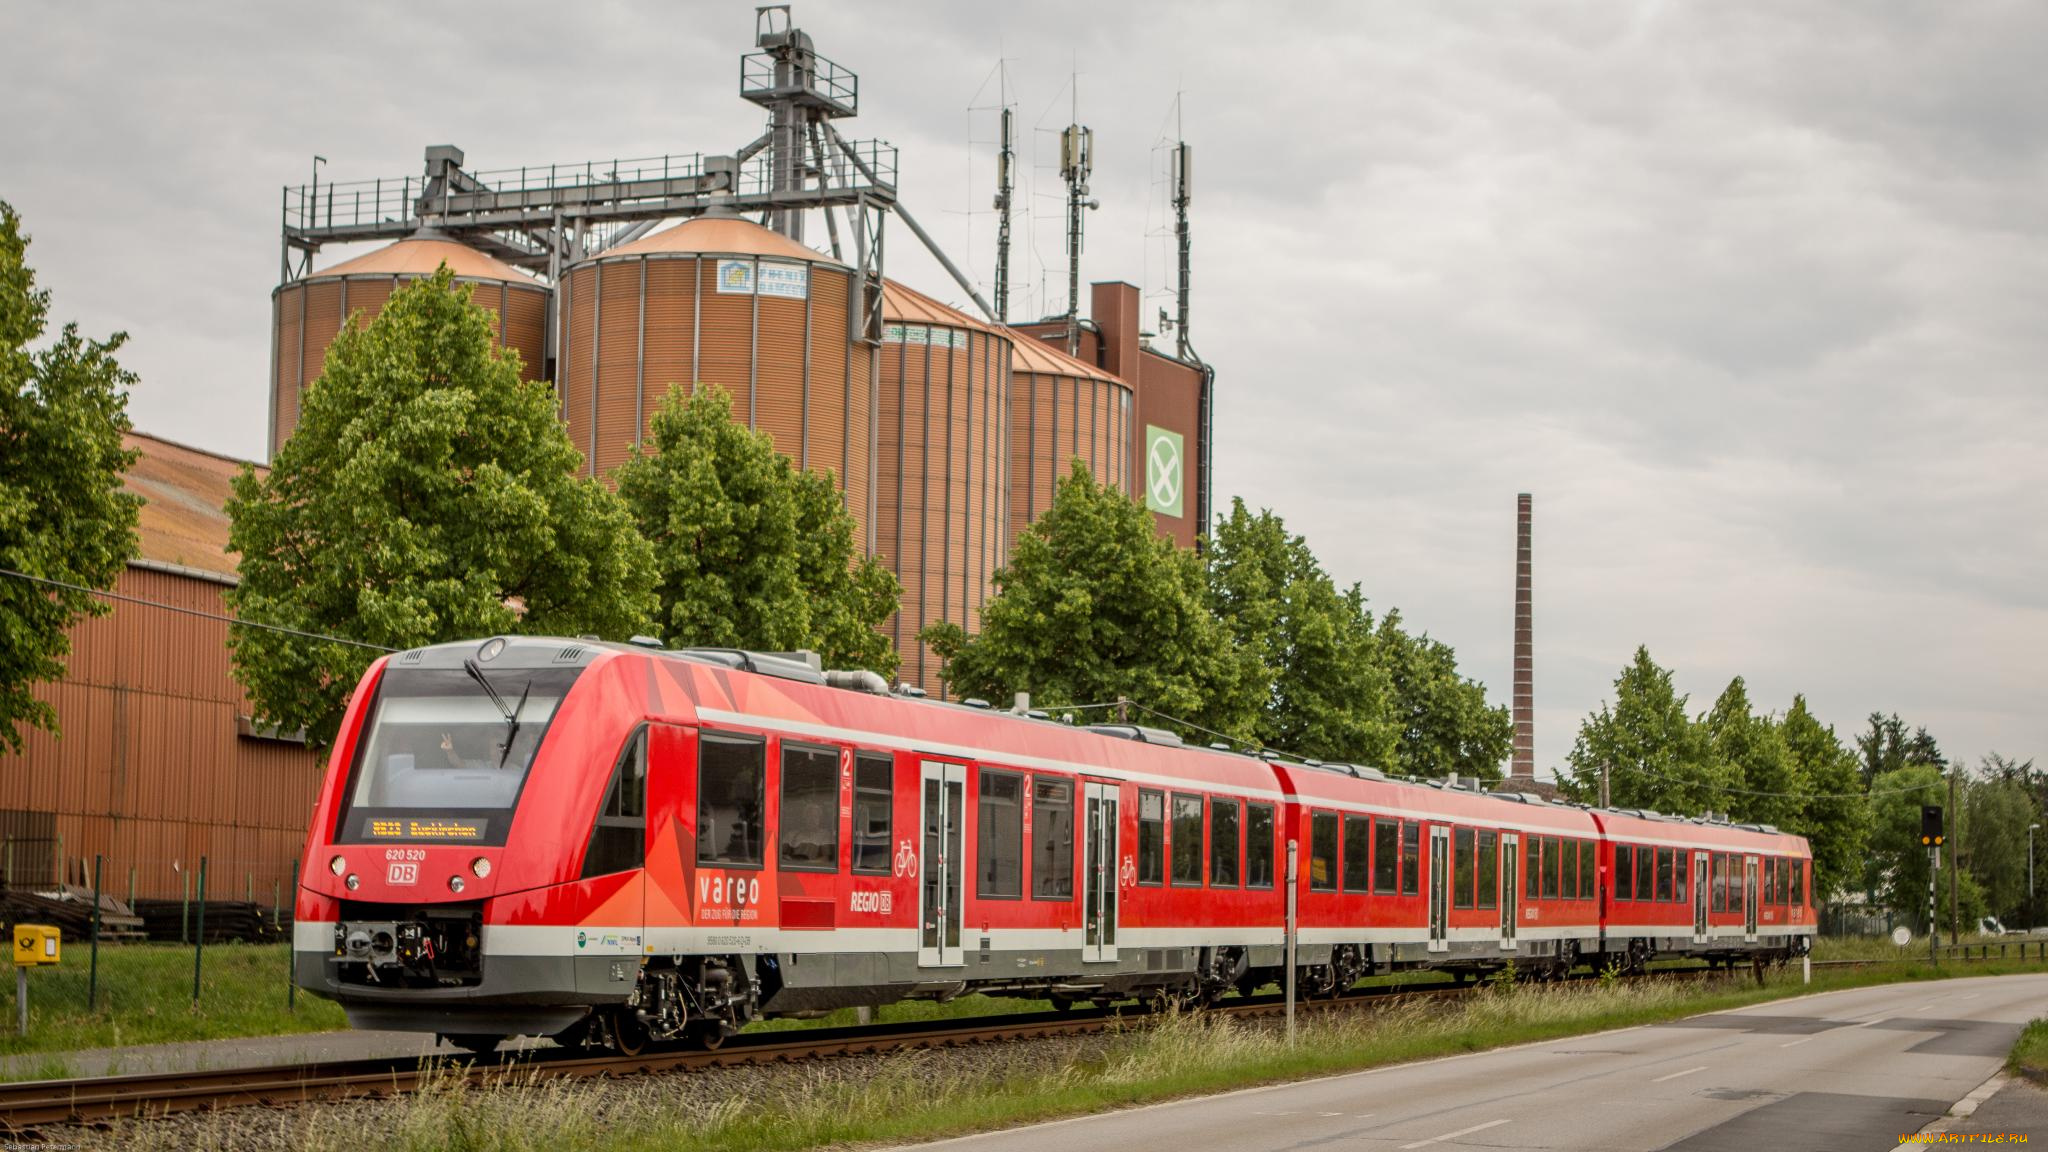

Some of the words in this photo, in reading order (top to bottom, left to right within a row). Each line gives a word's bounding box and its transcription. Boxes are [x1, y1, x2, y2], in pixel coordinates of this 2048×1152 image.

[843, 750, 851, 777] 2
[1024, 774, 1031, 798] 2
[385, 849, 405, 861] 620
[406, 850, 426, 861] 520
[389, 864, 416, 882] DB
[700, 877, 759, 905] vareo
[850, 891, 879, 912] REGIO
[881, 893, 891, 911] DB
[741, 909, 759, 920] REGION
